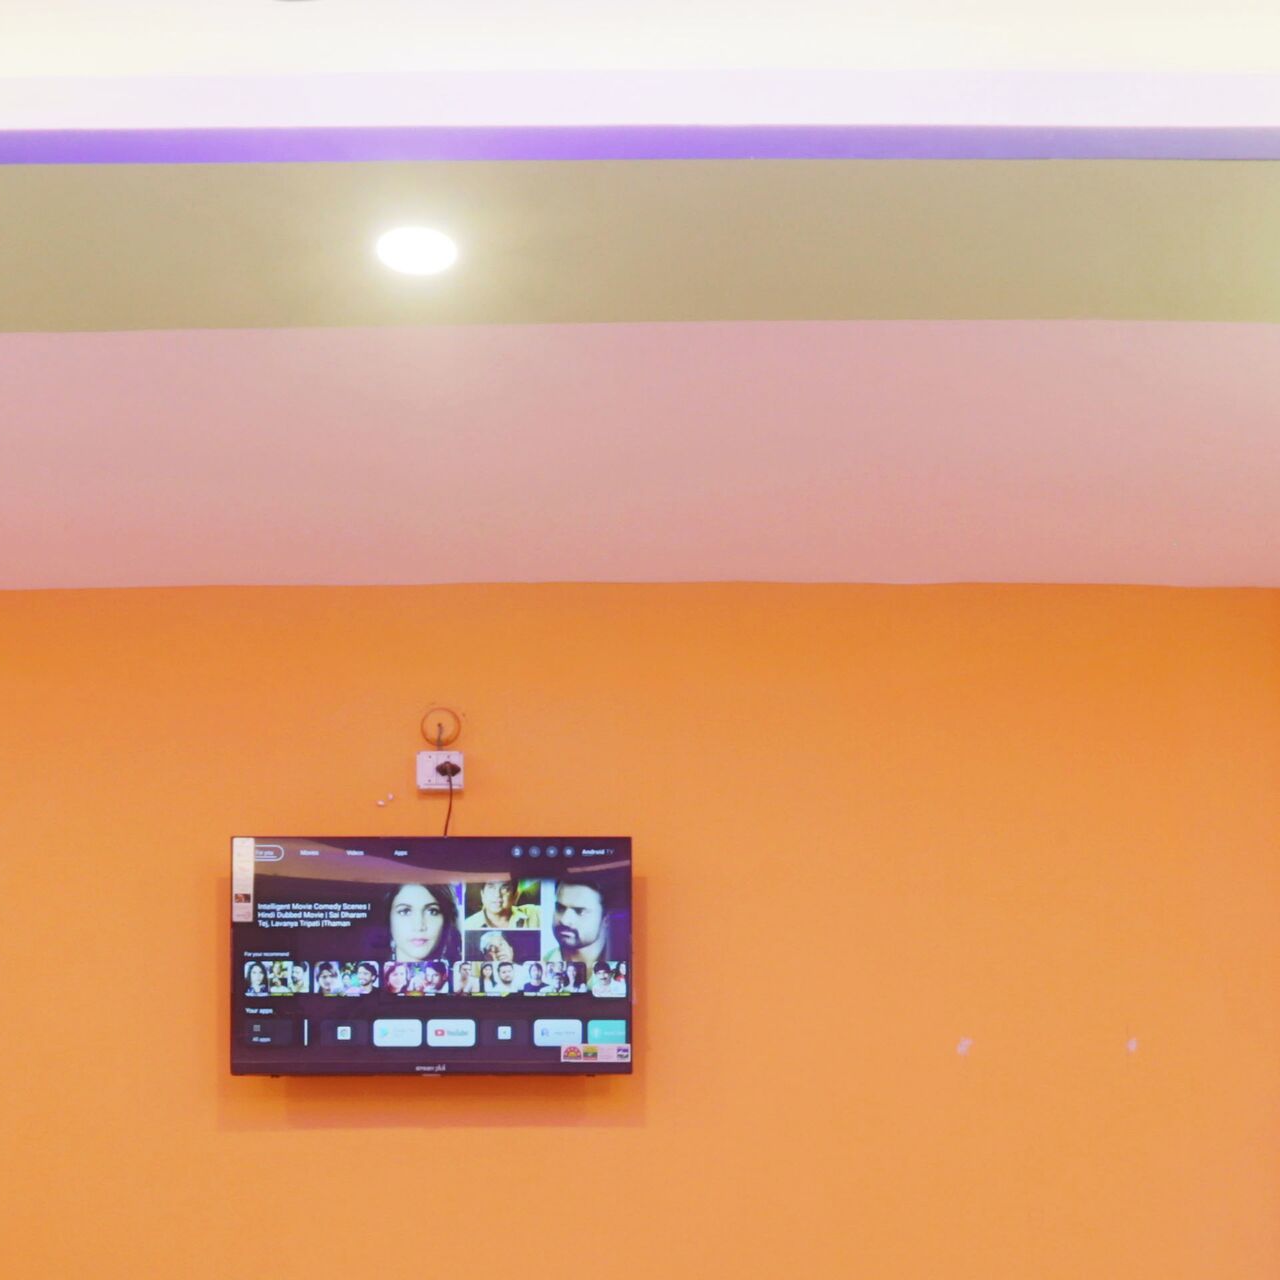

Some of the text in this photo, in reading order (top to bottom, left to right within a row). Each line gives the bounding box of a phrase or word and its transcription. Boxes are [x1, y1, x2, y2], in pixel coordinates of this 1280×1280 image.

[394, 849, 408, 857] Apps
[582, 848, 605, 856] Android
[258, 903, 291, 911] Intelligent
[314, 903, 341, 911] Comedy
[271, 920, 298, 928] Lavanya
